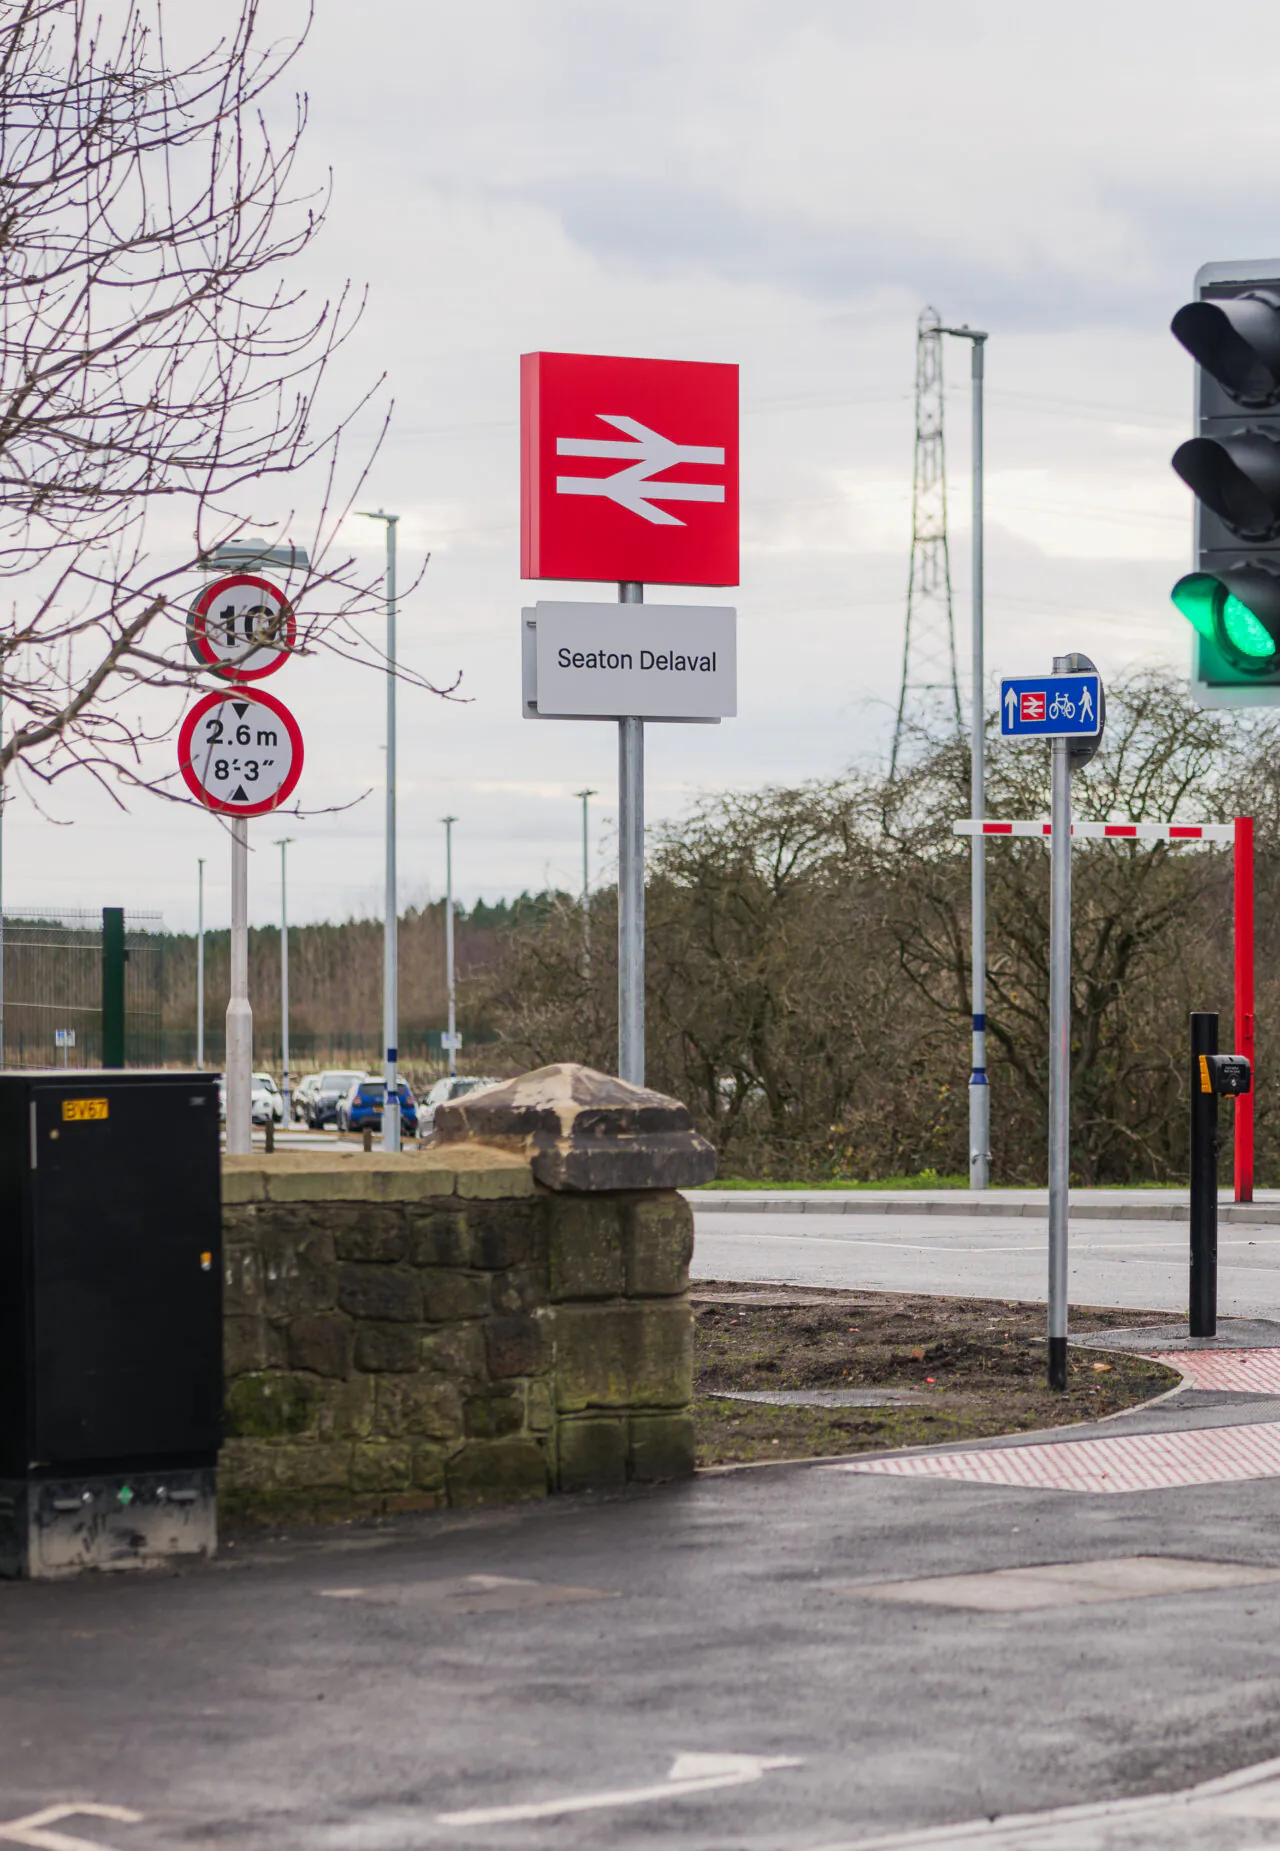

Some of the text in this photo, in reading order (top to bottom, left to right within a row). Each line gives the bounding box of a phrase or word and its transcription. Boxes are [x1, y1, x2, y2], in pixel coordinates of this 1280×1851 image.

[219, 604, 277, 646] 10
[557, 648, 717, 672] Seaton Delaval
